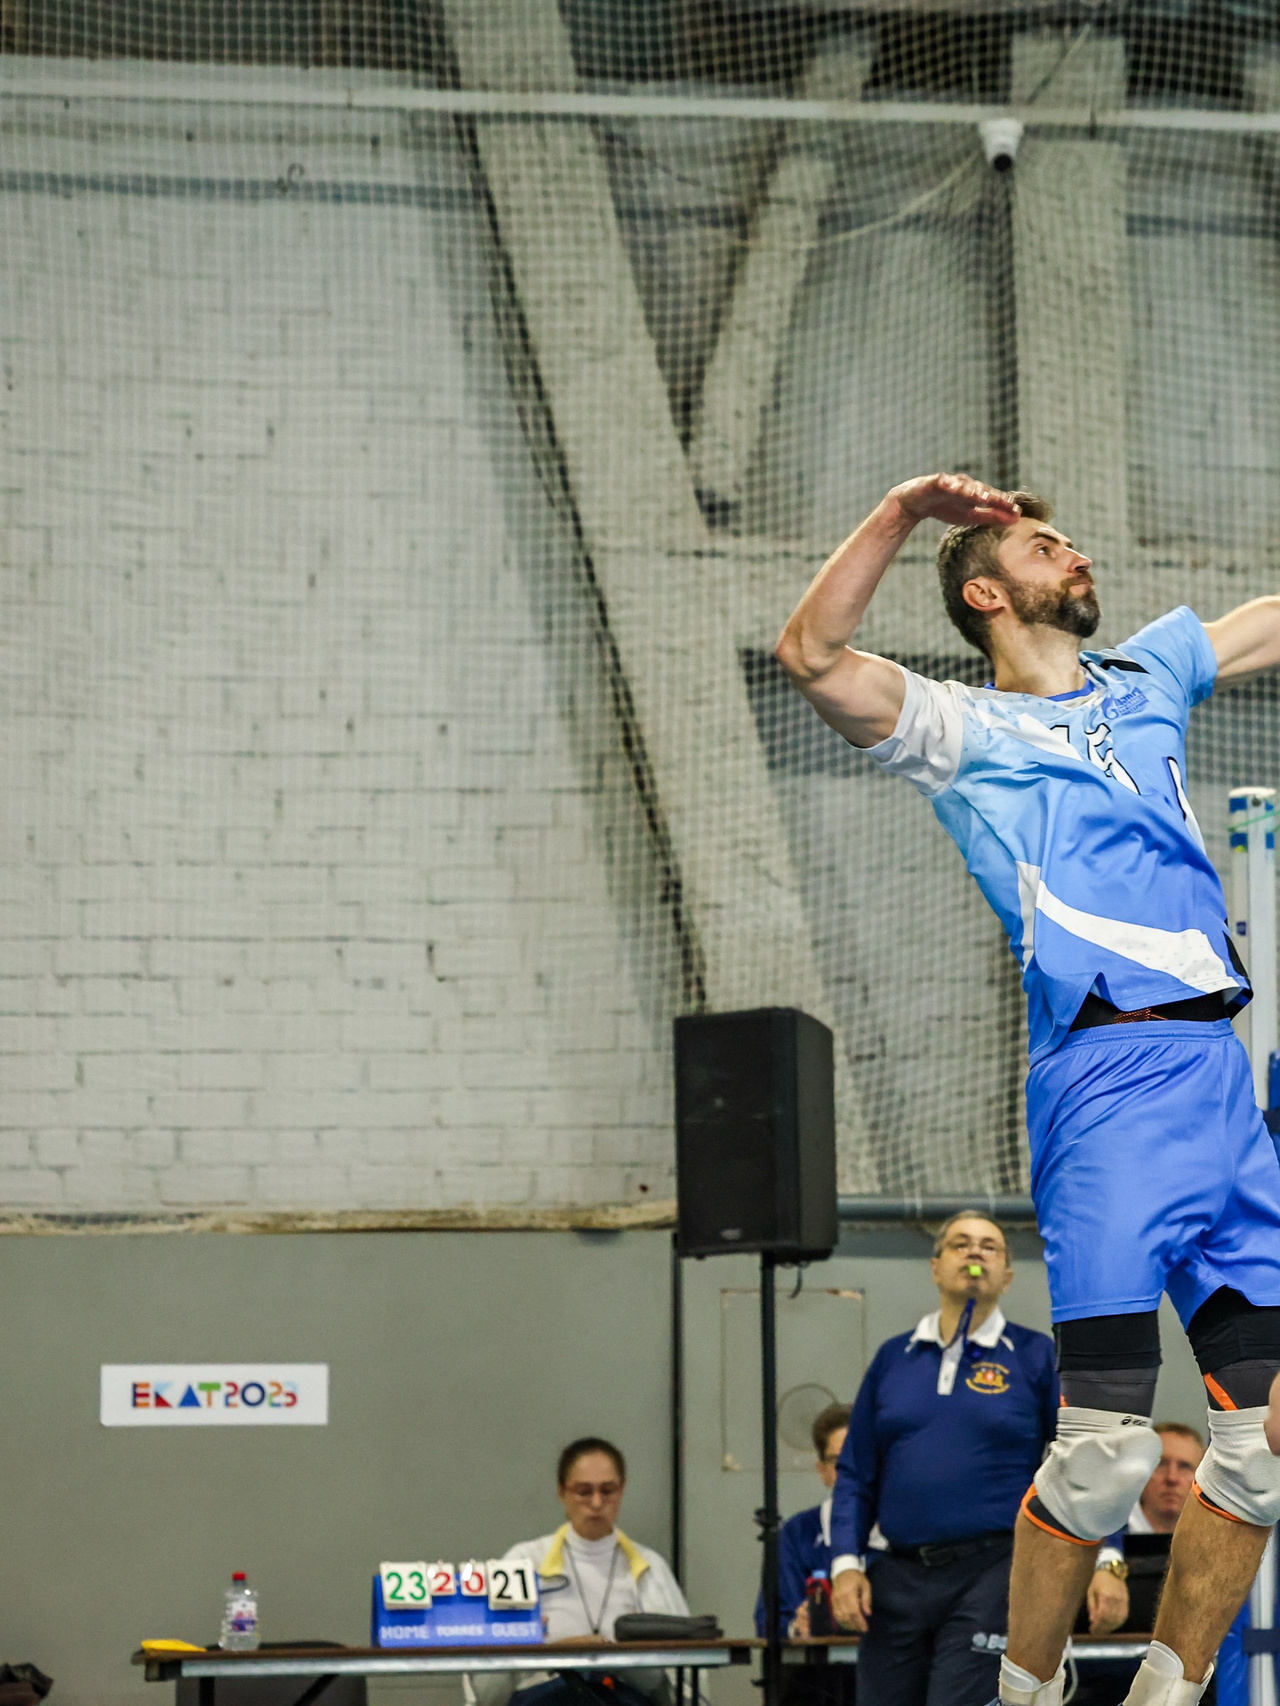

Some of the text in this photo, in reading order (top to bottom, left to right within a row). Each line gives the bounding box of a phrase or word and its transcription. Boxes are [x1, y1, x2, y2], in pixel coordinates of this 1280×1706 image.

[131, 1381, 298, 1408] EKAT2023
[386, 1569, 529, 1601] 23 2 0 21
[381, 1626, 430, 1639] HOME
[491, 1622, 538, 1637] GUEST
